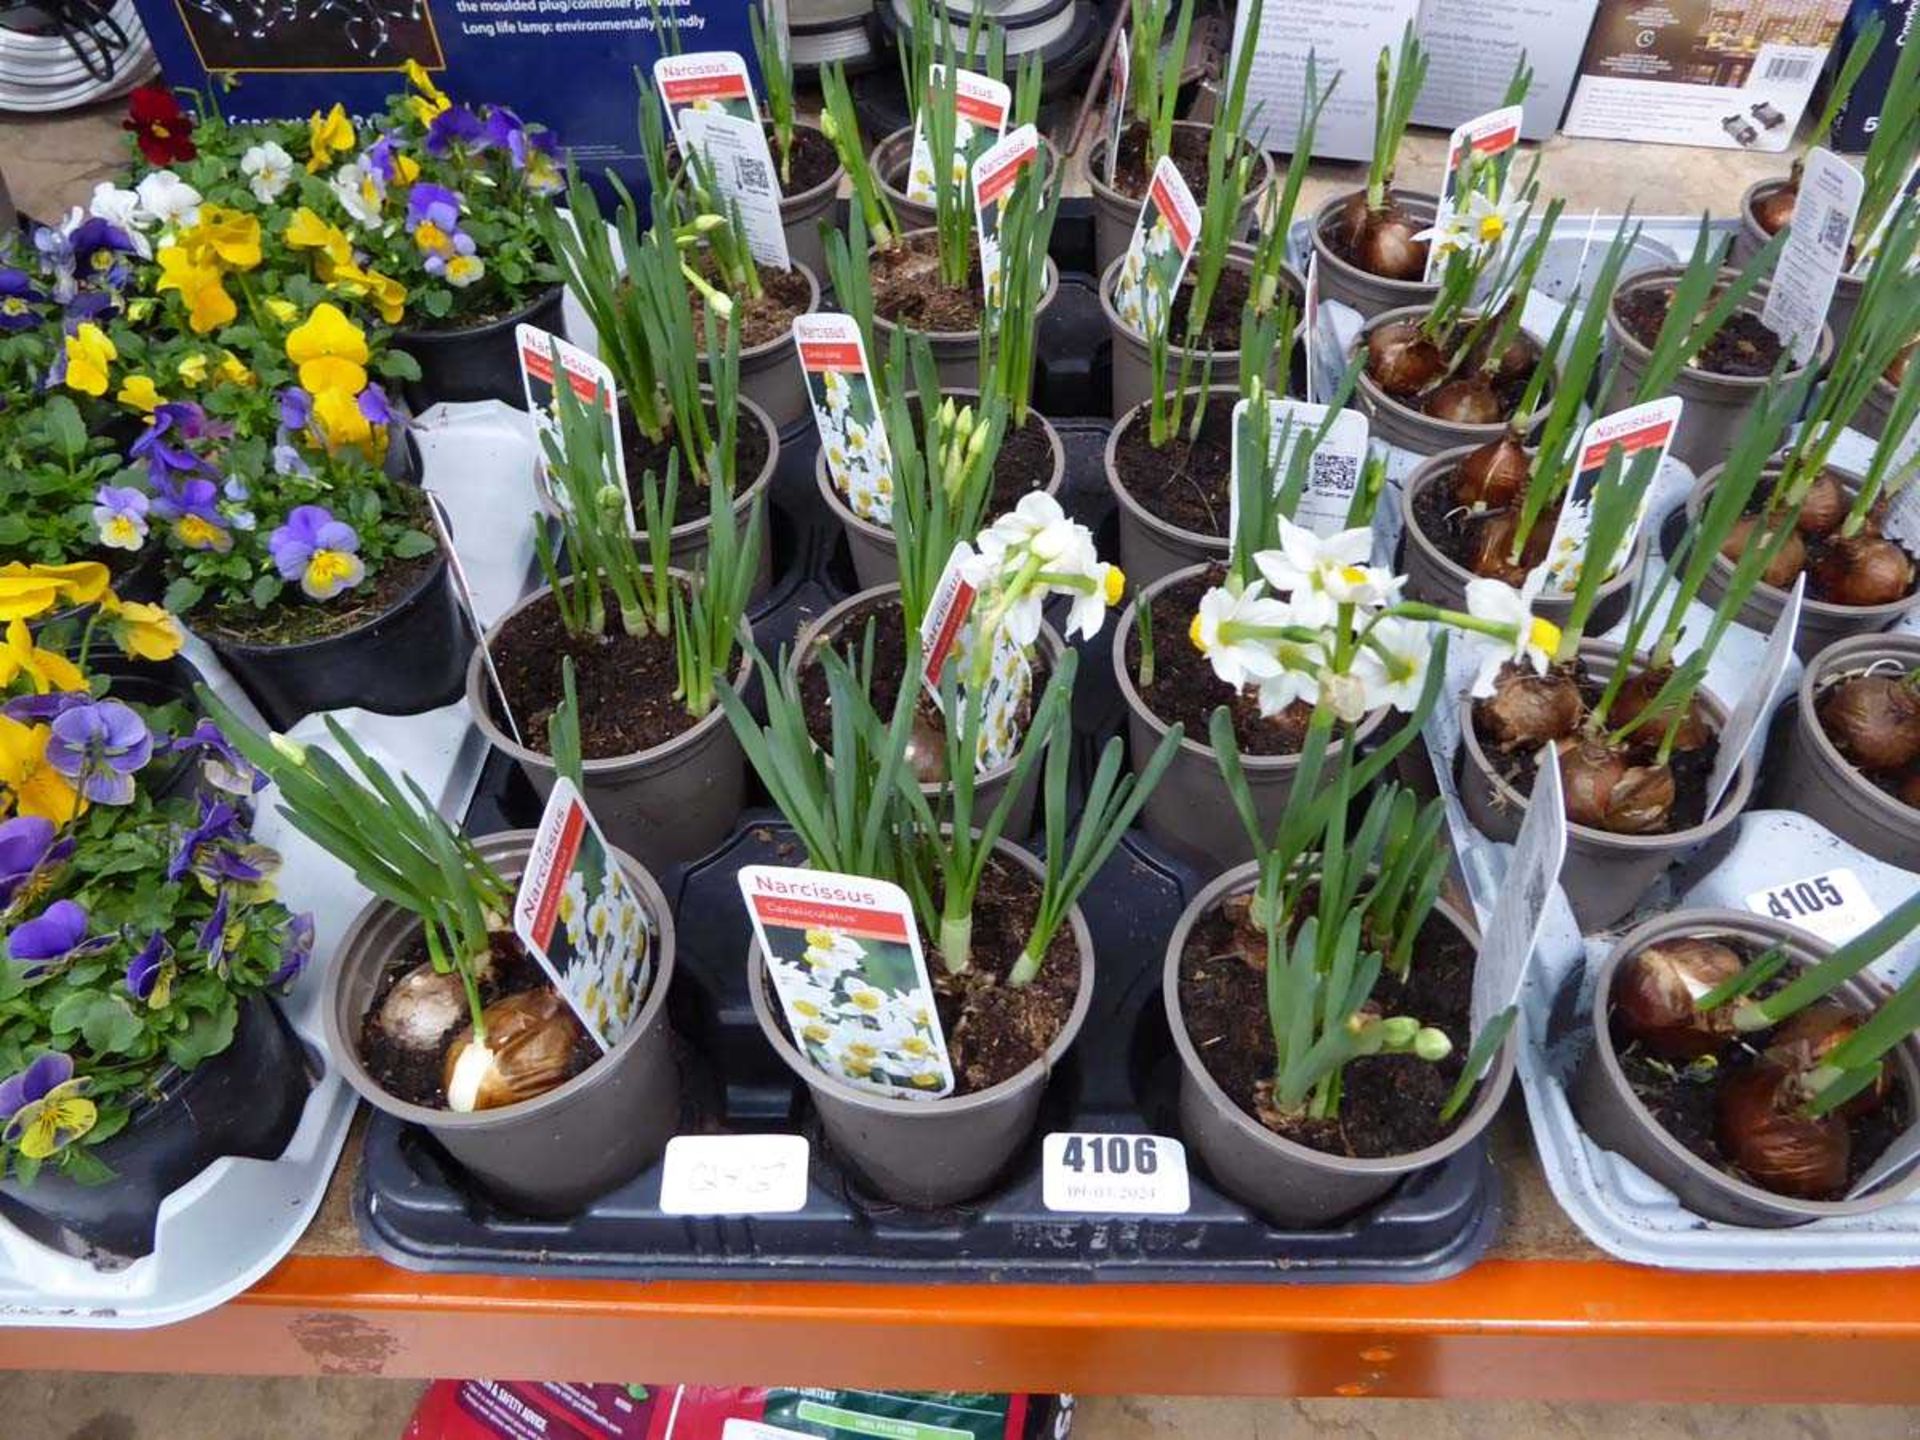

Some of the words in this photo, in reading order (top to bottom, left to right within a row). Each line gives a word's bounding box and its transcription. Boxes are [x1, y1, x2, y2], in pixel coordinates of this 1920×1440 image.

[457, 0, 478, 12] the
[479, 0, 536, 12] moulded
[462, 21, 496, 37] Long
[495, 20, 516, 34] life
[516, 20, 554, 35] lamp:
[555, 17, 656, 32] environmentally
[523, 807, 566, 922] Narcissus
[755, 874, 876, 906] Narcissus
[1766, 876, 1845, 920] 4105
[1062, 1136, 1158, 1175] 4106
